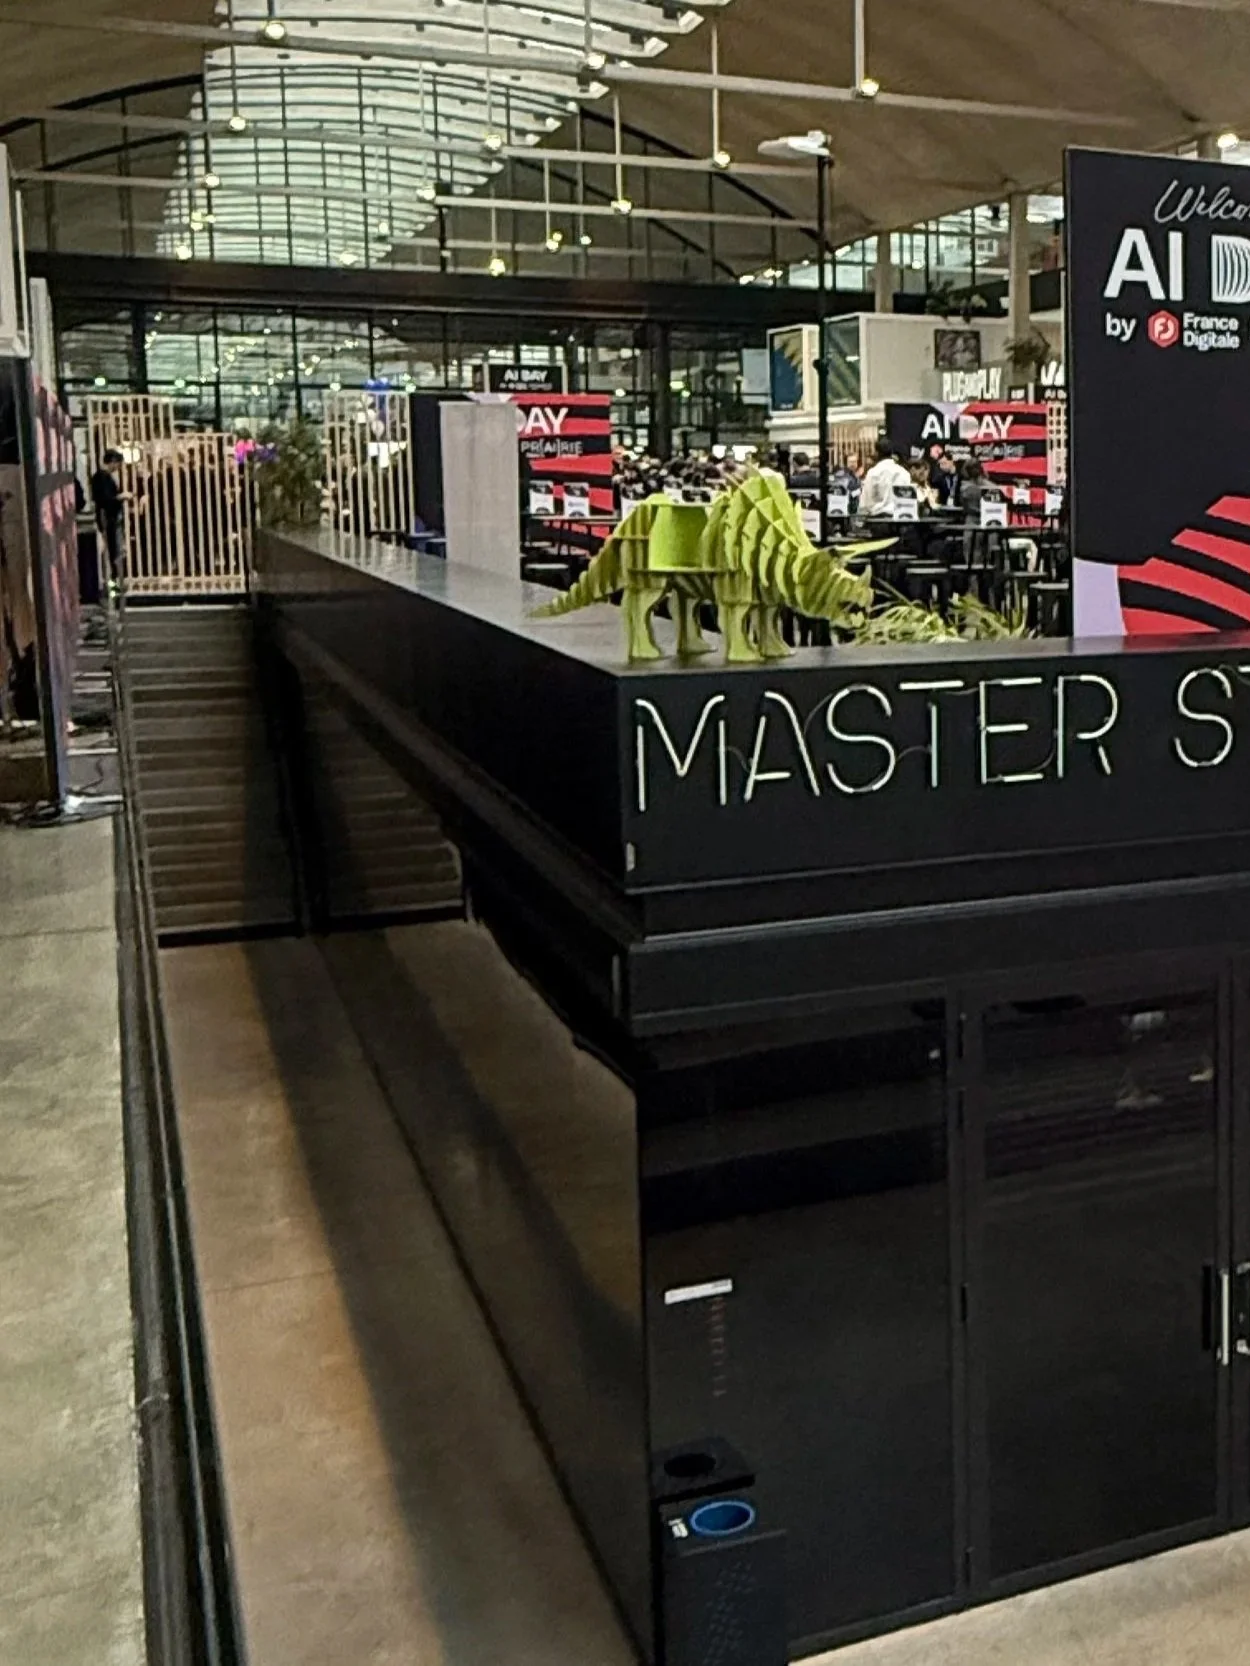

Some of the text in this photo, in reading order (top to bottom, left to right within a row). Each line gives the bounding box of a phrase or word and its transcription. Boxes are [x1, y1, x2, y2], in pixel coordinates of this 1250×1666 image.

[1103, 228, 1184, 301] AI
[1105, 312, 1137, 342] by
[1183, 312, 1240, 332] France
[1183, 331, 1241, 351] Digitale
[921, 413, 1014, 440] AI DAY
[634, 672, 1119, 812] MASTER
